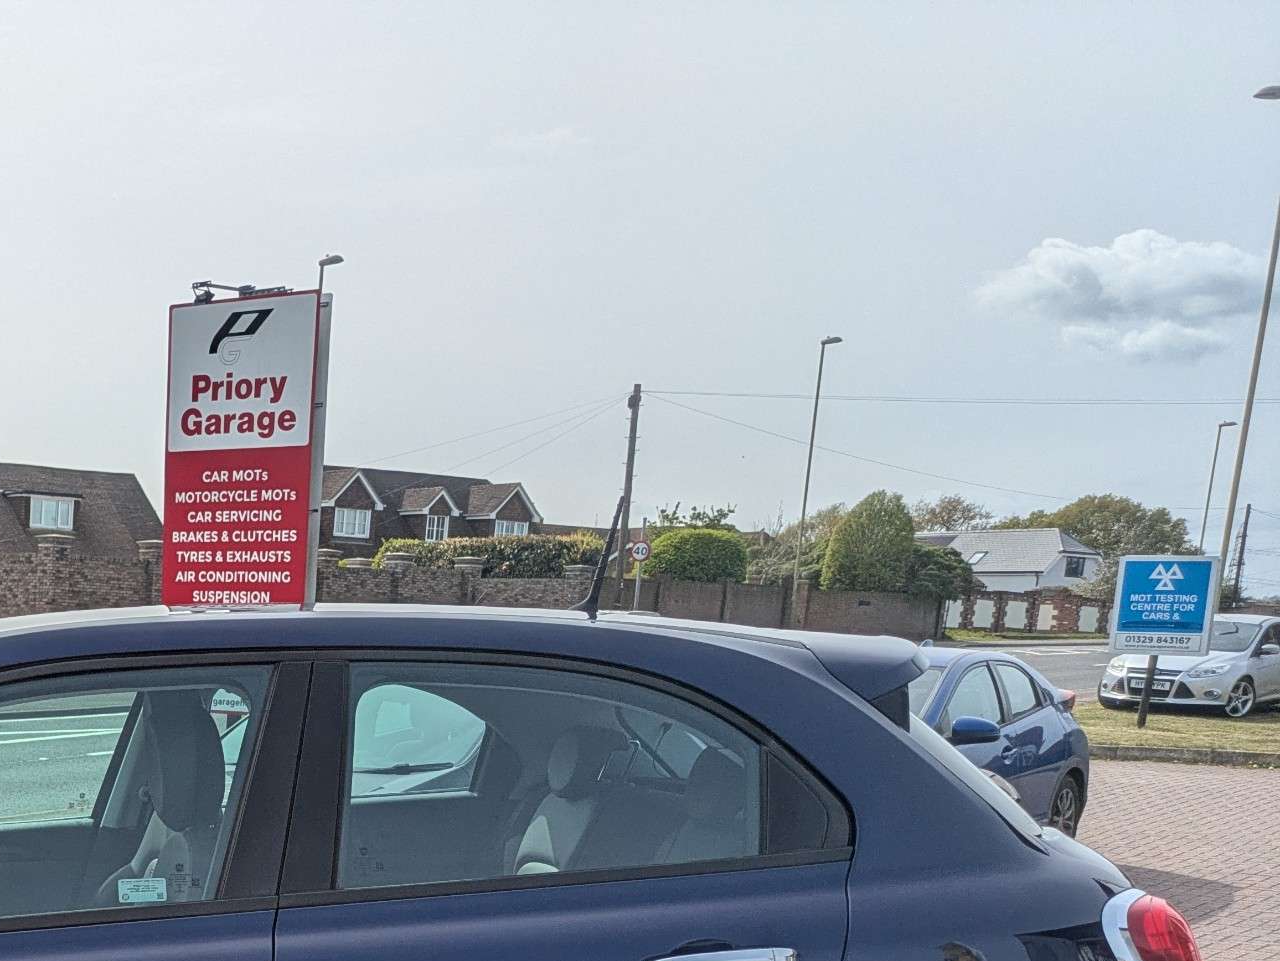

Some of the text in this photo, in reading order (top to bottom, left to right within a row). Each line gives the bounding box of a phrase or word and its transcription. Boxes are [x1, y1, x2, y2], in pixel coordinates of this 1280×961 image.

[191, 372, 288, 404] Priory
[181, 408, 297, 438] Garage
[202, 469, 268, 482] CAR MOTs
[175, 489, 297, 503] MOTORCYCLE MOTs
[187, 510, 282, 522] CAR SERVICING
[172, 530, 297, 542] BRAKES & CLUTCHES
[176, 551, 291, 562] TYRES & EXHAUSTS
[634, 546, 647, 555] 40
[175, 571, 291, 583] AIR CONDITIONING
[192, 591, 270, 603] SUSPENSION
[1130, 594, 1198, 603] MOT TESTING
[1130, 603, 1195, 611] CENTRE FOR
[1142, 612, 1180, 620] CARS &
[1124, 635, 1191, 645] 01329 843167
